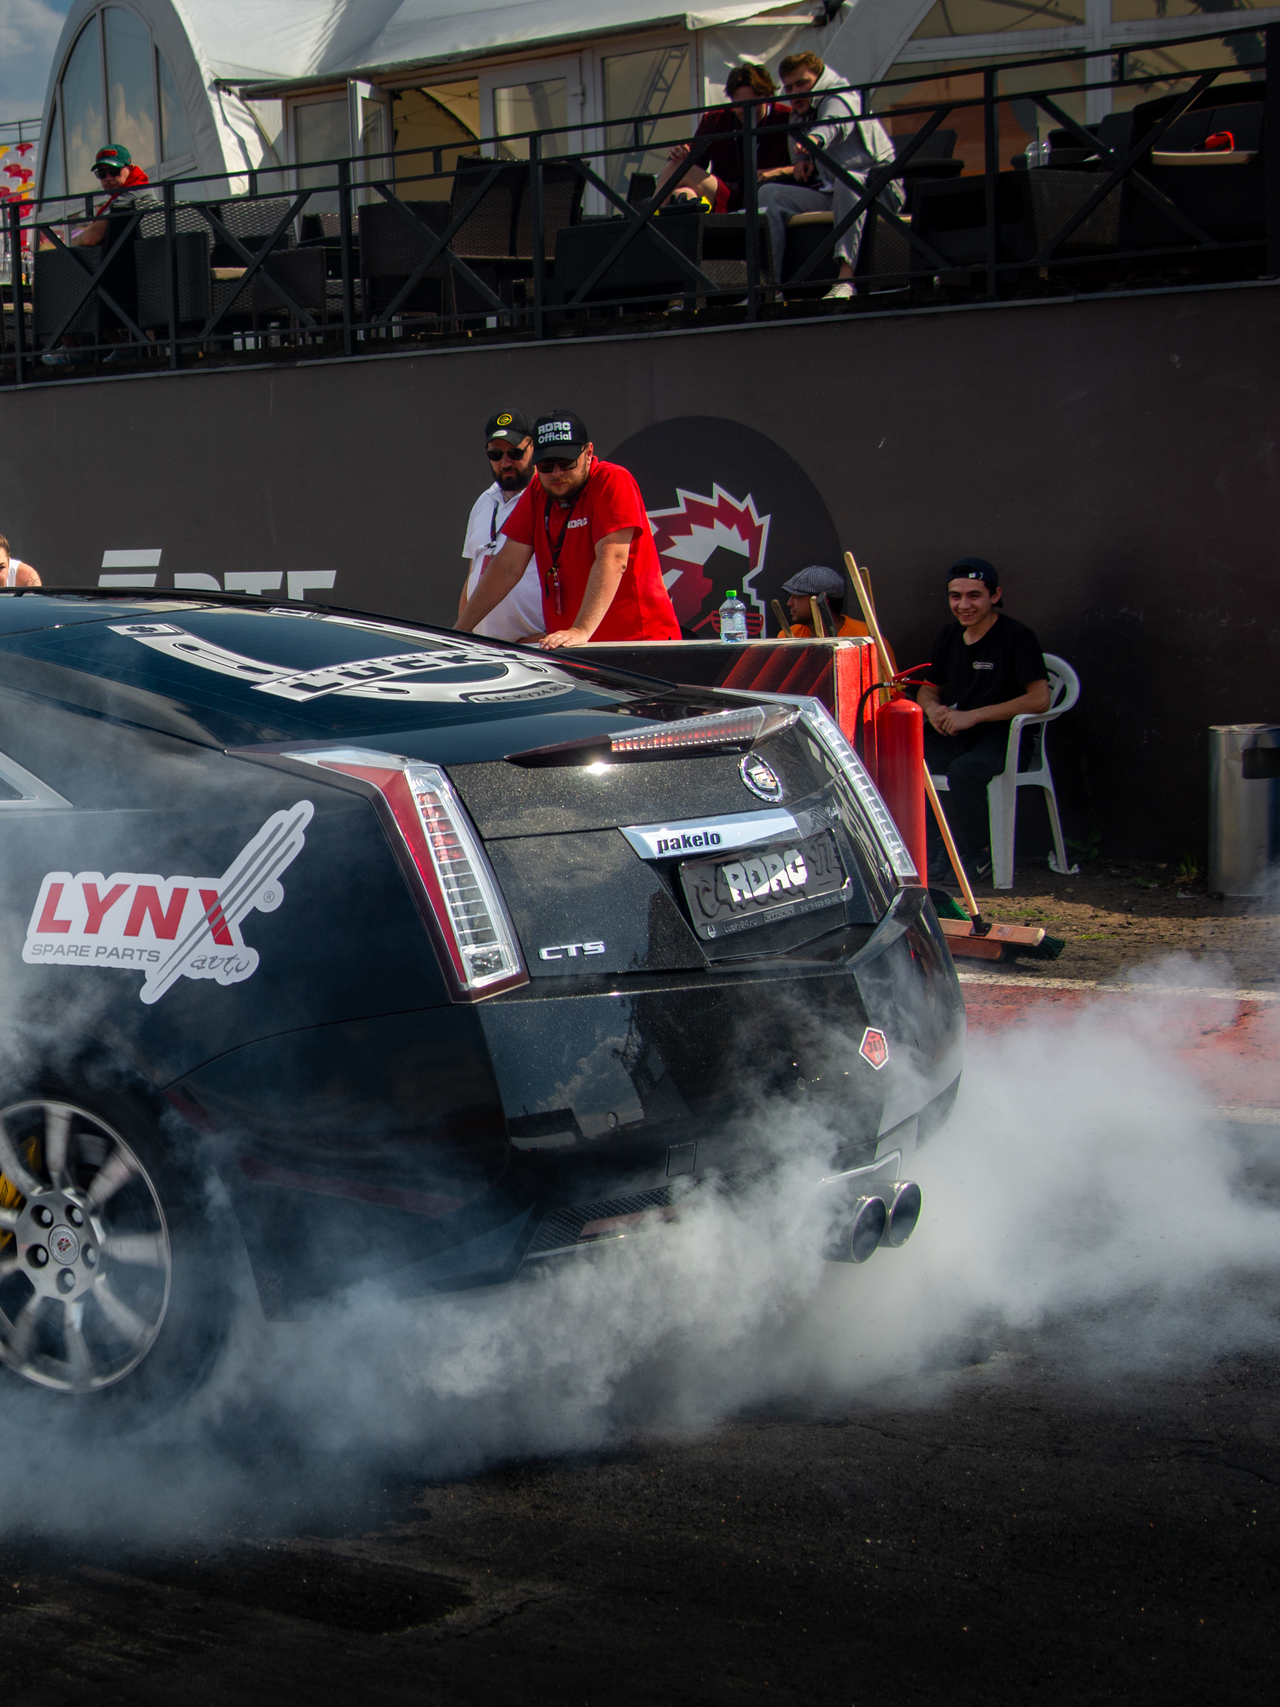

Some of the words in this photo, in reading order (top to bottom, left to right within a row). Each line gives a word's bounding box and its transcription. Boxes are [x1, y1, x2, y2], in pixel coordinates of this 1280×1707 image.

[538, 421, 572, 435] RDRC
[289, 653, 526, 693] LUCKY
[657, 832, 721, 854] pakelo
[722, 849, 808, 902] RDRC
[36, 883, 234, 946] LYNX
[31, 944, 91, 957] SPARE
[95, 946, 161, 963] PARTS
[539, 941, 605, 960] CTS
[190, 953, 250, 976] auto
